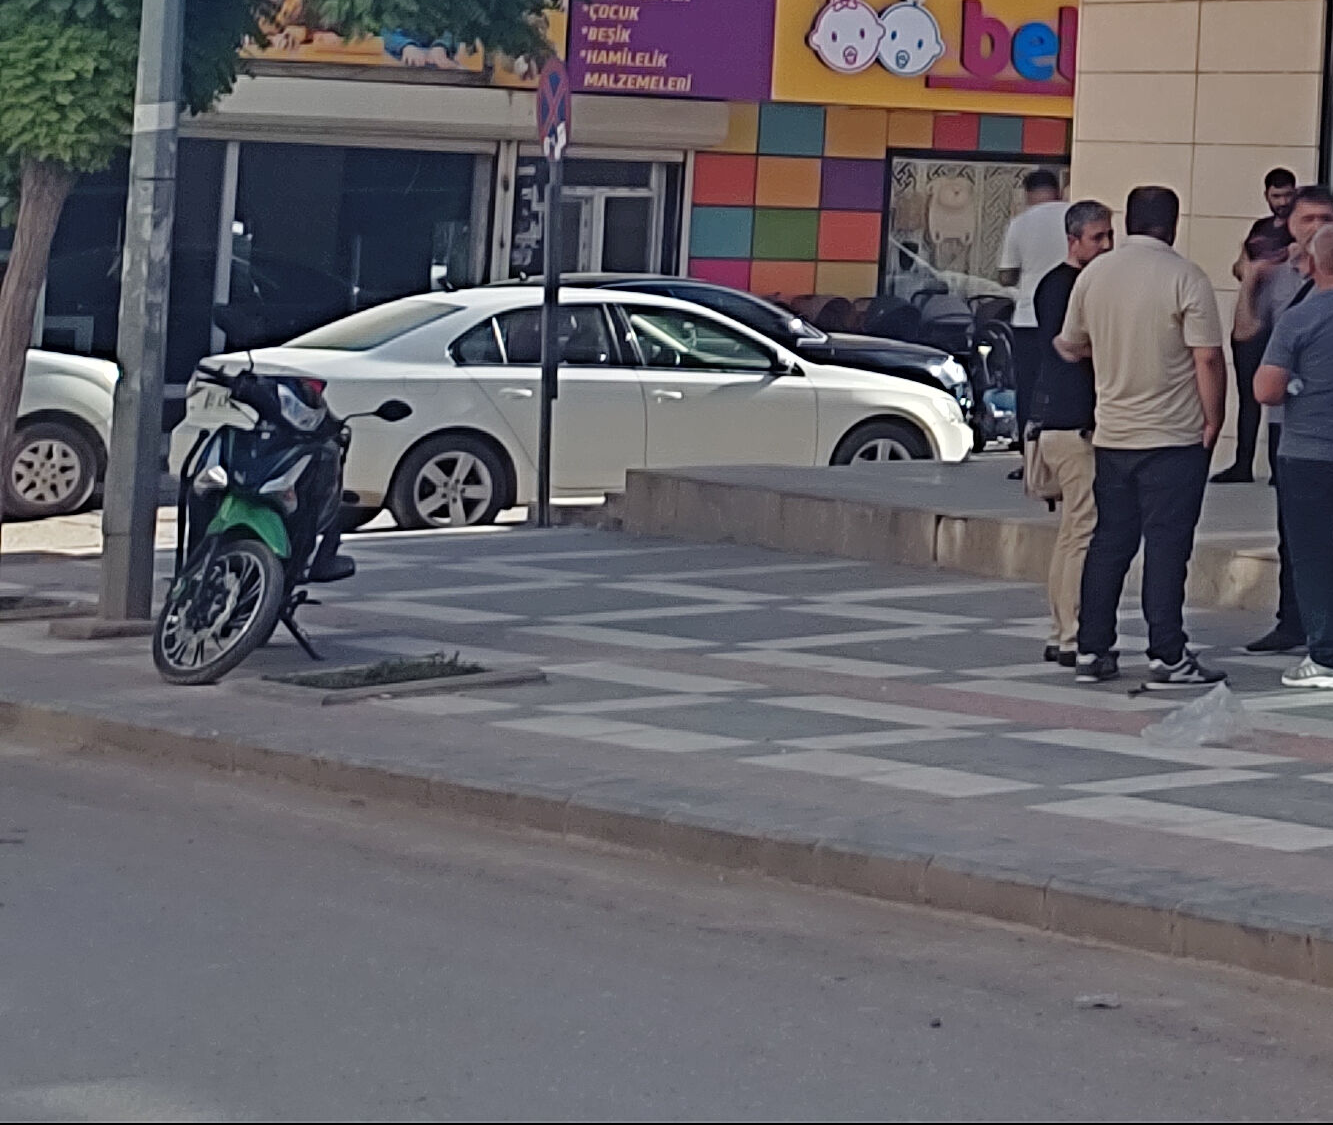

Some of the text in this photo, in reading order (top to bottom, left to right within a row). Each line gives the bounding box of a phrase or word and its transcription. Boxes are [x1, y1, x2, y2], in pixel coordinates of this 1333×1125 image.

[589, 4, 640, 22] ÇOCUK
[587, 25, 632, 45] BEŞİK
[586, 47, 669, 68] HAMİLELİK
[583, 72, 692, 92] MALZEMELERİ
